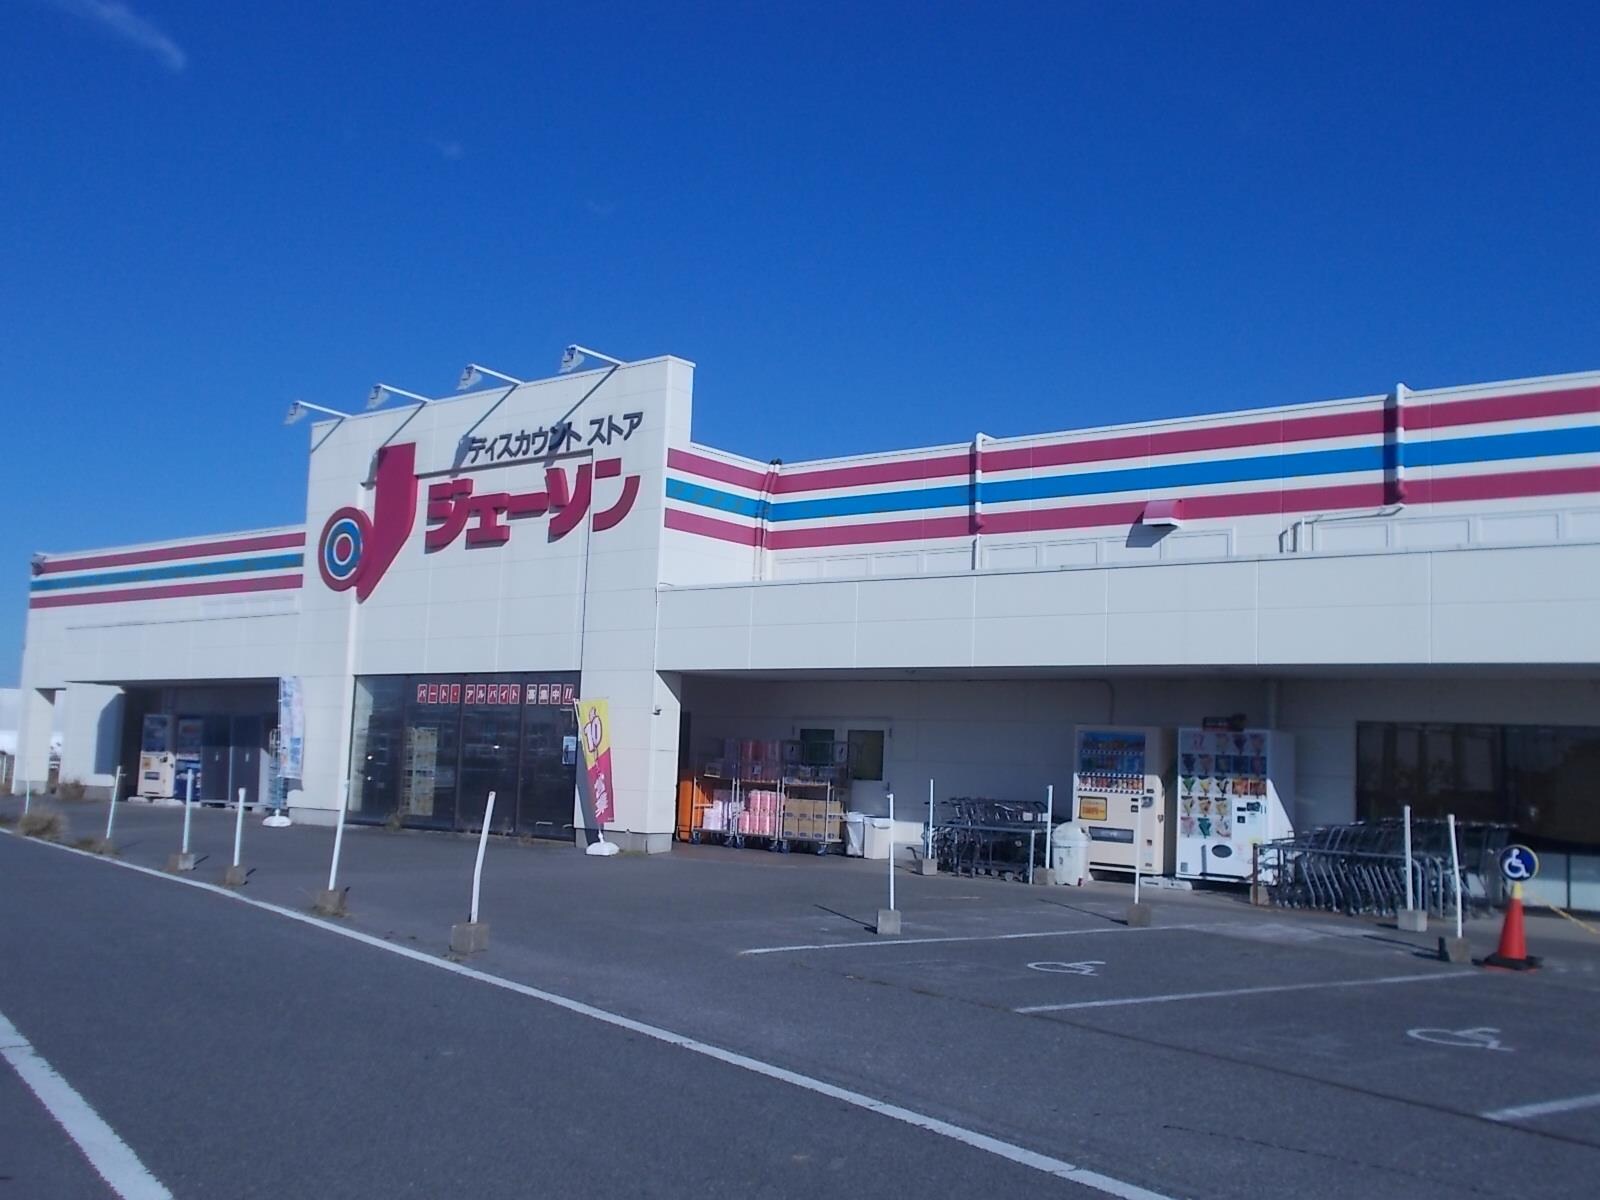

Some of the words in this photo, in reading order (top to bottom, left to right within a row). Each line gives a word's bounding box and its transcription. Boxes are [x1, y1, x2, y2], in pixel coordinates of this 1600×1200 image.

[587, 411, 643, 446] ストア
[425, 457, 641, 554] ジェーソン
[466, 686, 520, 701] アルバイト
